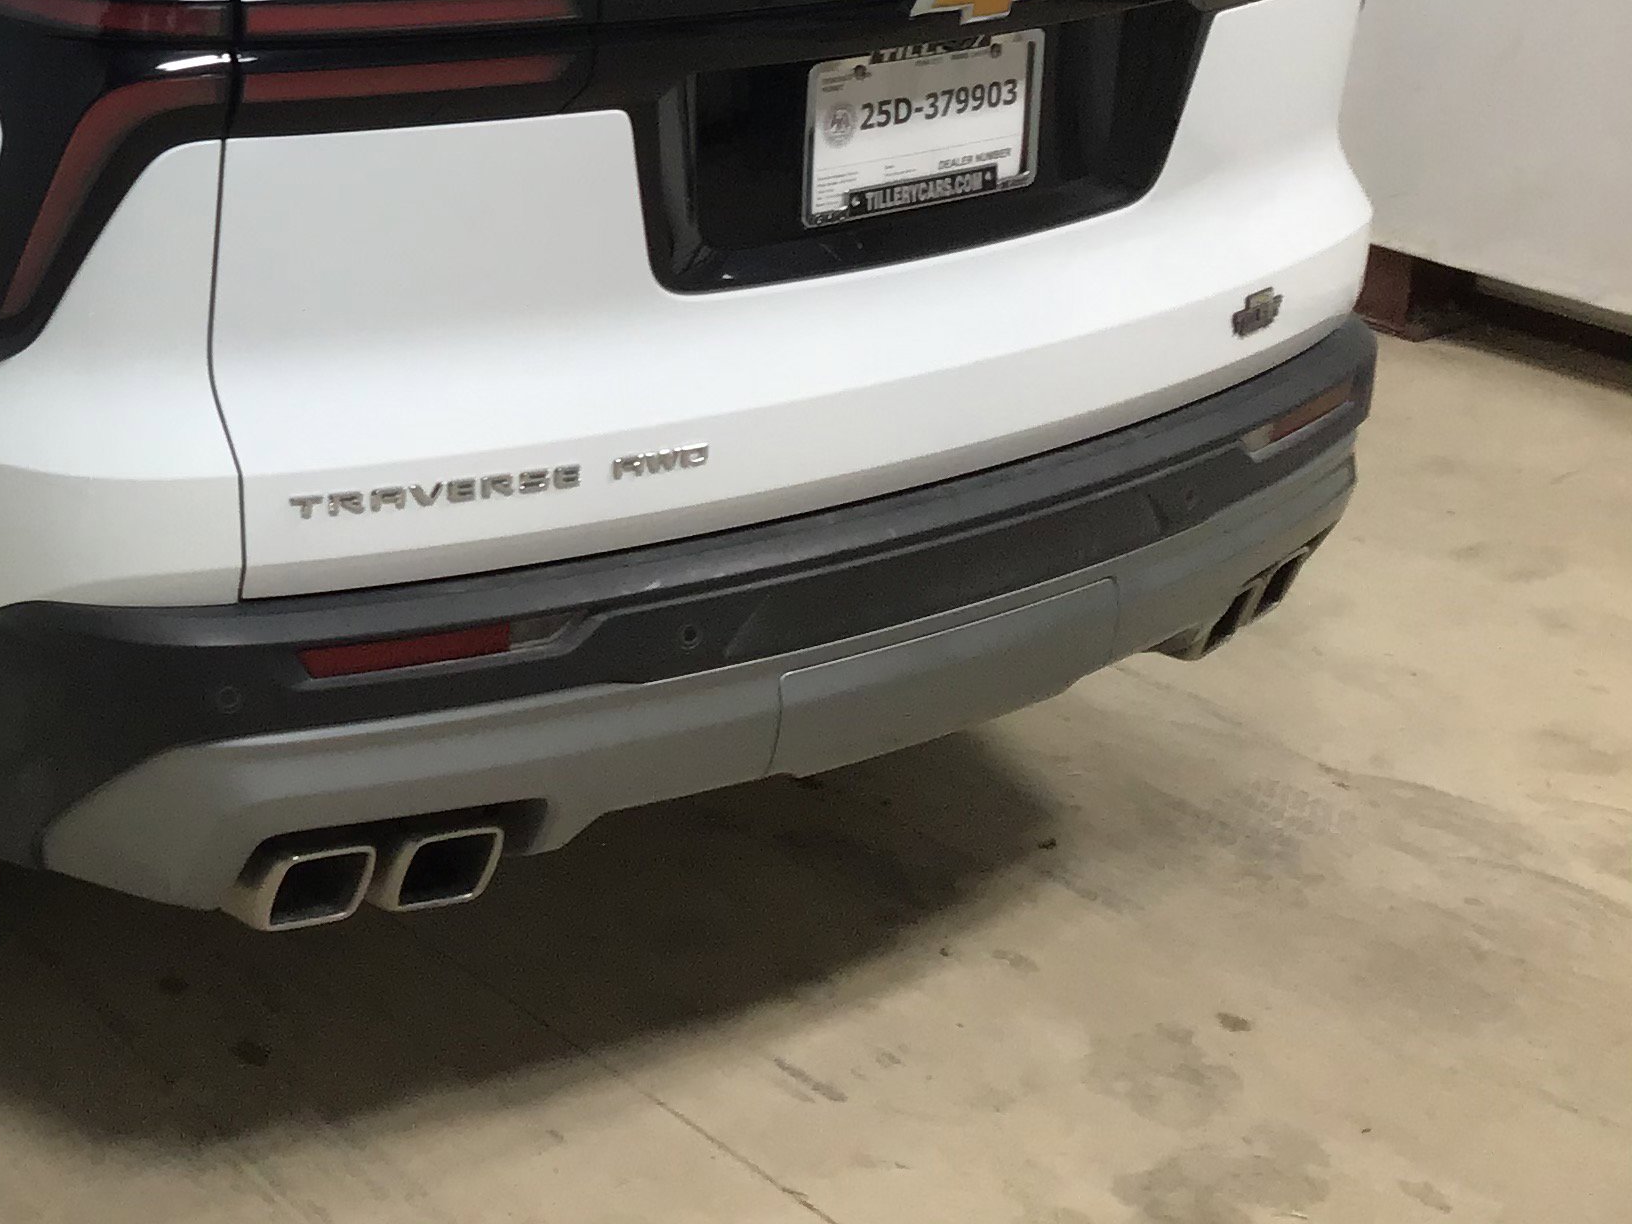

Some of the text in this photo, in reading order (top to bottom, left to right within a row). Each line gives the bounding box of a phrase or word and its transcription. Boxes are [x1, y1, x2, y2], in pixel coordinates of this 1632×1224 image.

[860, 78, 1018, 131] 25D-379903
[865, 171, 983, 211] TILLERYCARS.COM
[289, 442, 710, 520] TRAVERSE AWD
